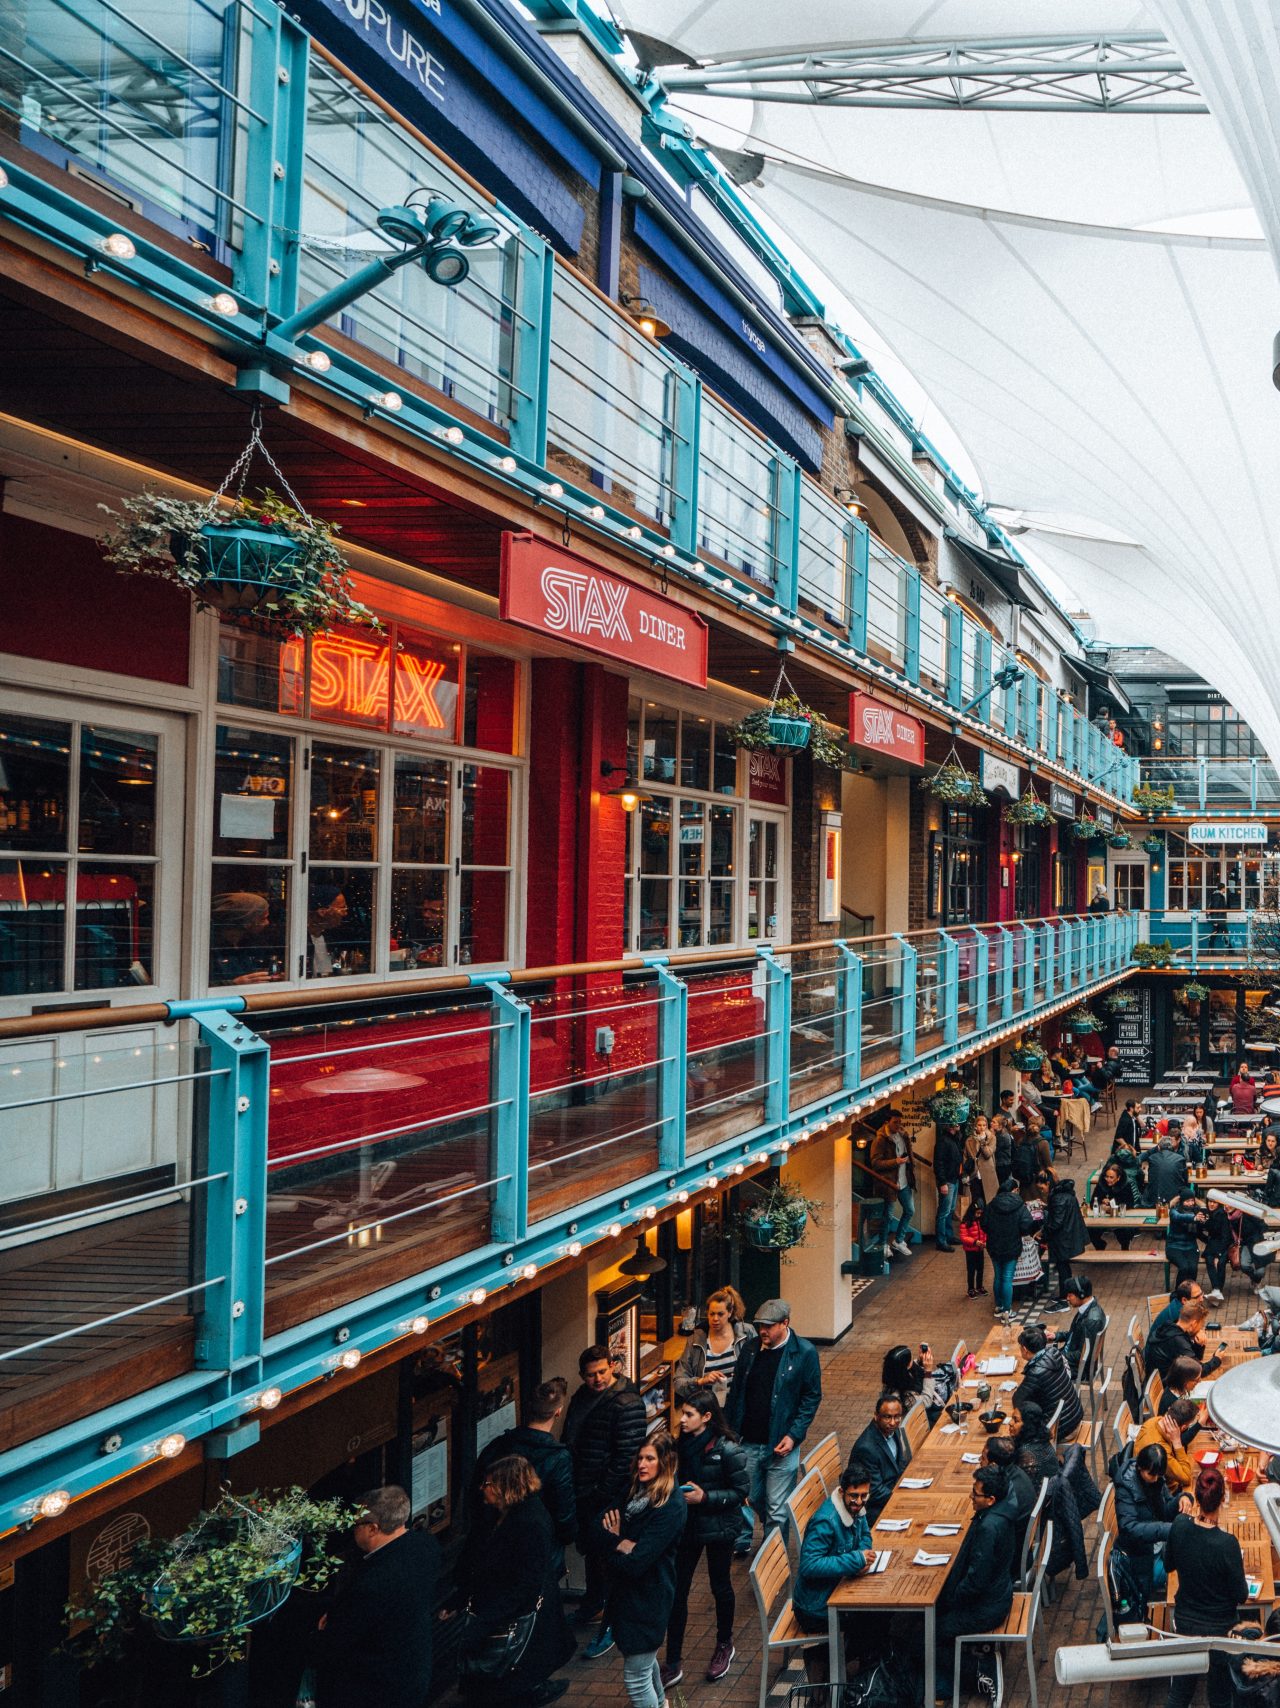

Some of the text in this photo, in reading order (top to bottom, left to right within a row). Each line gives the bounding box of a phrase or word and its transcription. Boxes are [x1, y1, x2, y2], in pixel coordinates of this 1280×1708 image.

[541, 566, 686, 650] STAX DINER
[310, 631, 447, 729] STAX
[863, 707, 916, 745] STAX DINER
[1191, 826, 1266, 840] RUM KITCHEN
